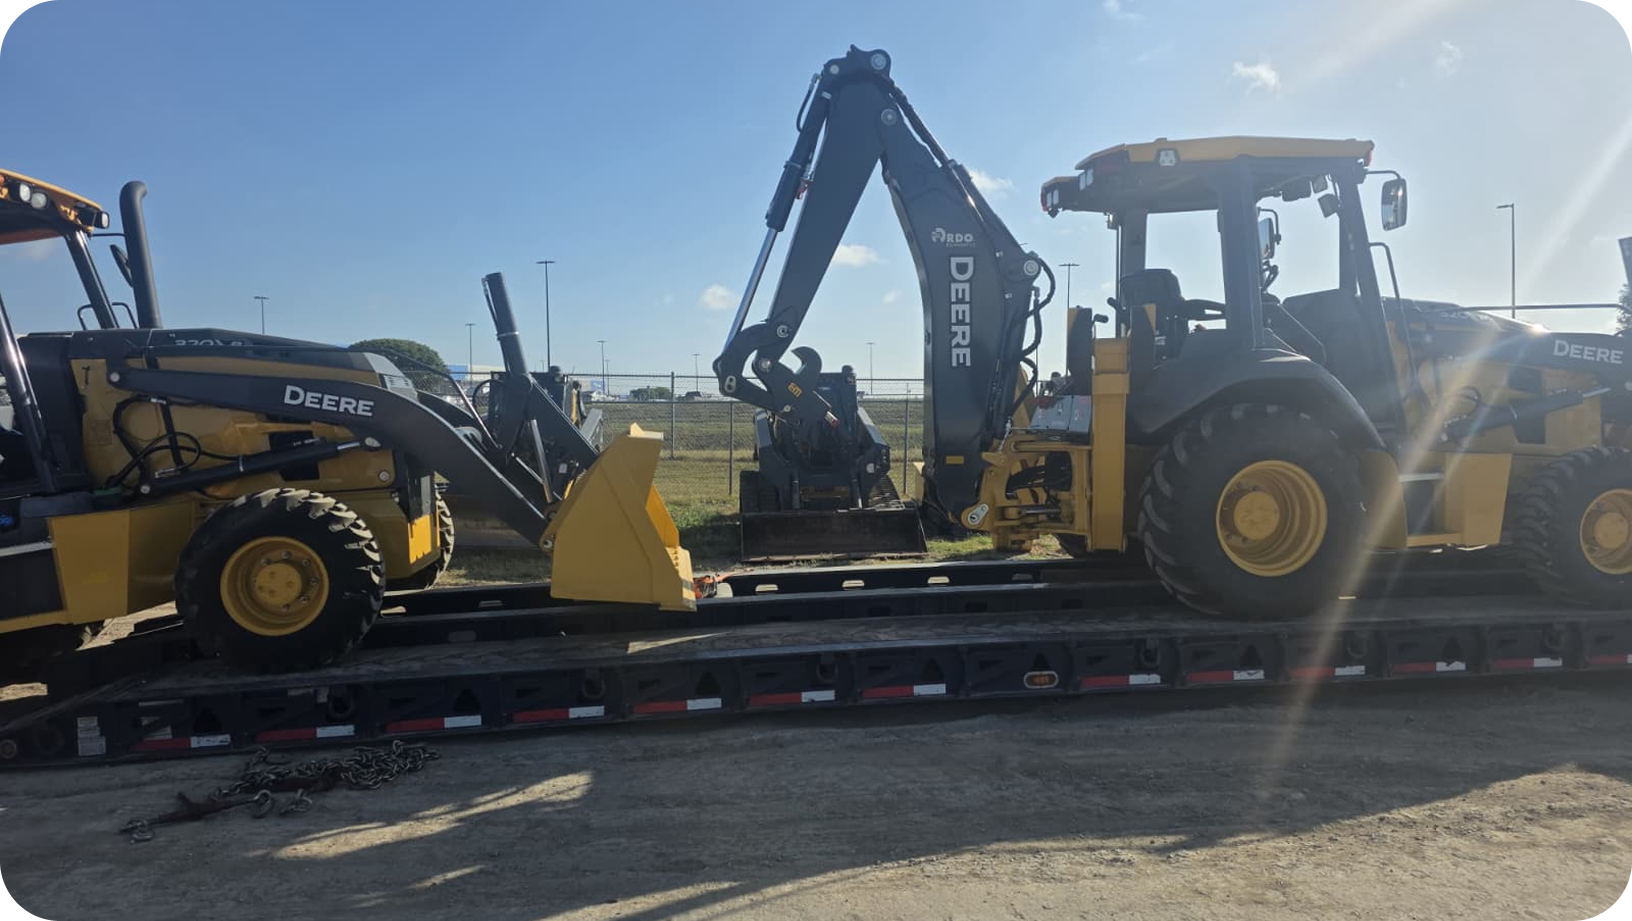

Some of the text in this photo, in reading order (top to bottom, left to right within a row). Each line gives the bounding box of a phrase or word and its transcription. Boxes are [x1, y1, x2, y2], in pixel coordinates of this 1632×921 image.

[946, 233, 974, 243] RDO
[950, 256, 974, 367] DEERE
[1553, 340, 1624, 365] DEERE
[283, 384, 375, 417] DEERE
